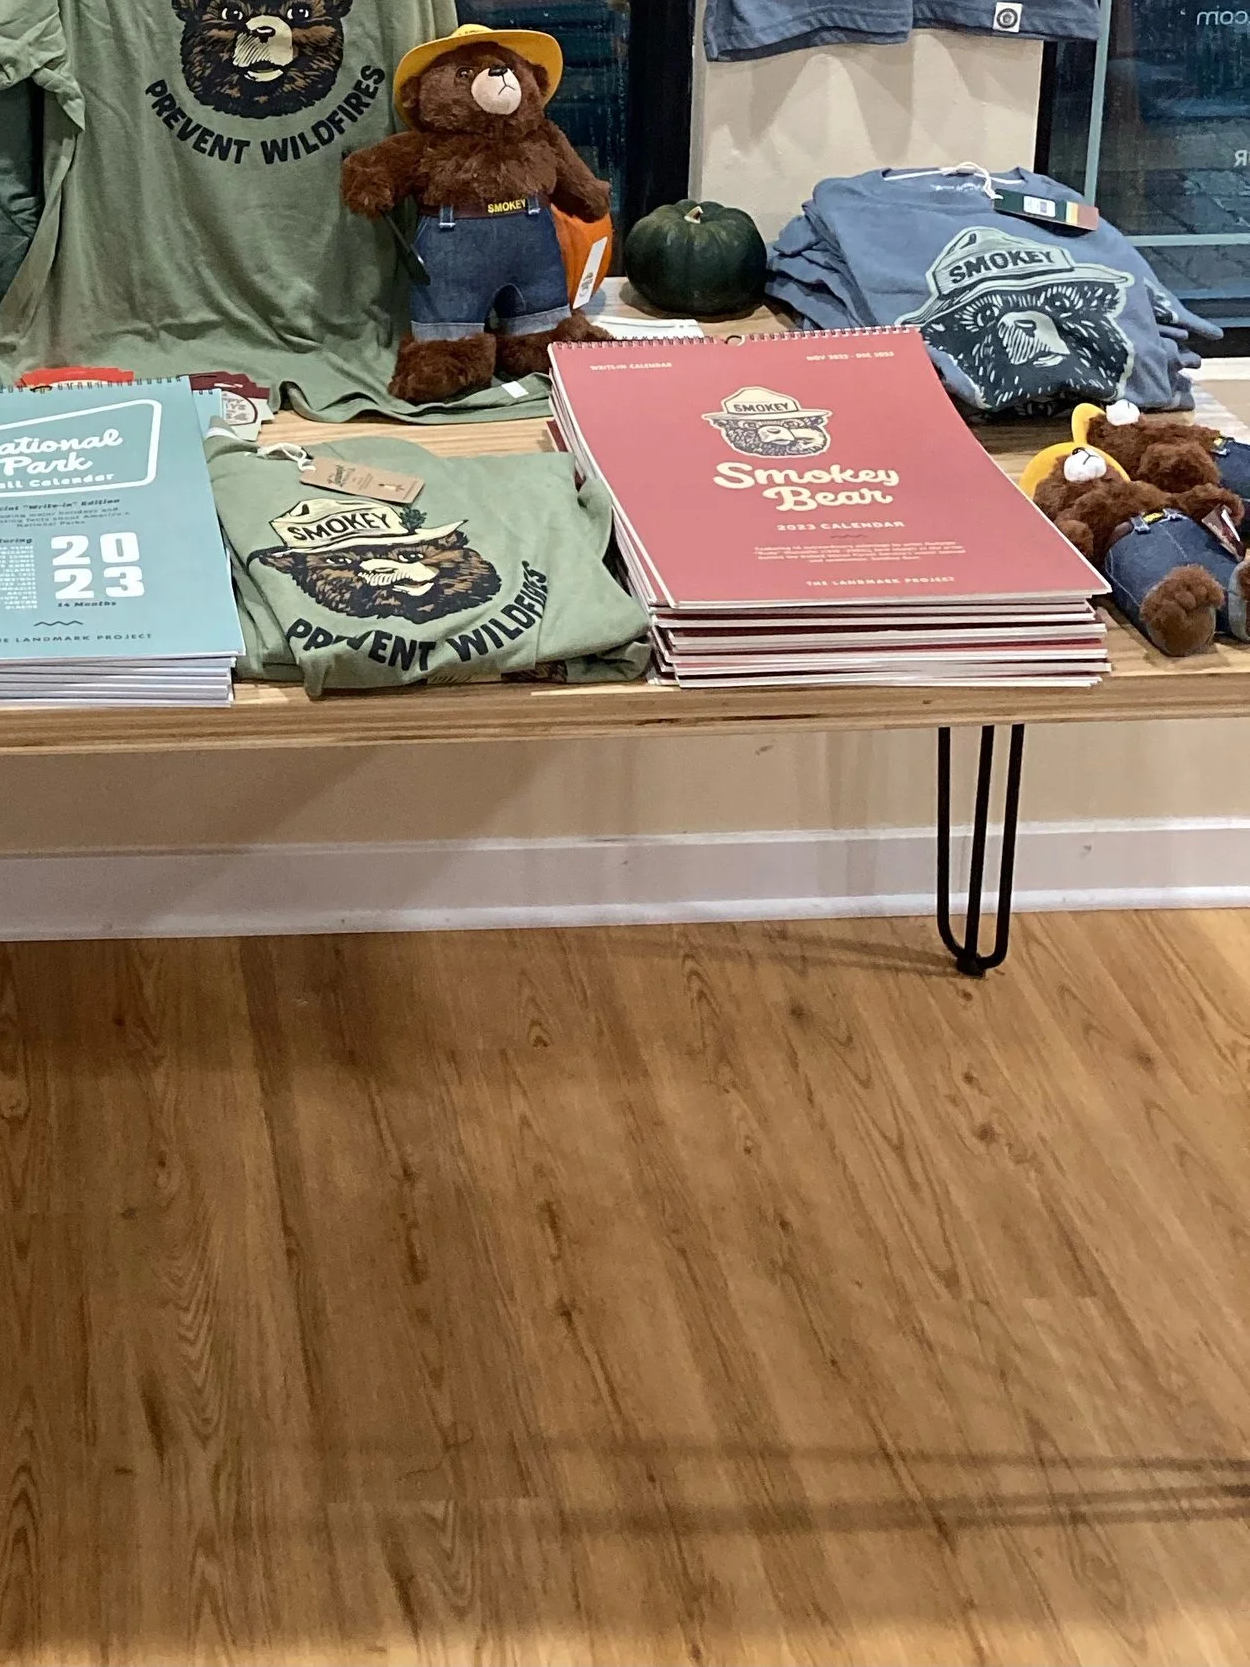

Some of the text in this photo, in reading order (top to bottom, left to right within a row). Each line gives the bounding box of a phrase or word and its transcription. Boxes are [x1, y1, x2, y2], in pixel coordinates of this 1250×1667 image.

[145, 63, 386, 165] PREVENT WILDFIRES
[487, 198, 528, 215] SMOKEY
[949, 250, 1054, 284] SMOKEY
[629, 362, 673, 370] CALENDAR
[733, 402, 789, 412] SMOKEY
[29, 473, 115, 488] Calendar
[713, 461, 900, 489] Smokey
[762, 485, 894, 512] Bear
[287, 512, 390, 542] SMOKEY
[777, 521, 905, 531] 2023 CALENDAR
[832, 578, 901, 586] LANDMARK
[904, 576, 955, 584] PROJECT
[16, 635, 90, 643] LANDMARK
[97, 633, 152, 641] PROJECT
